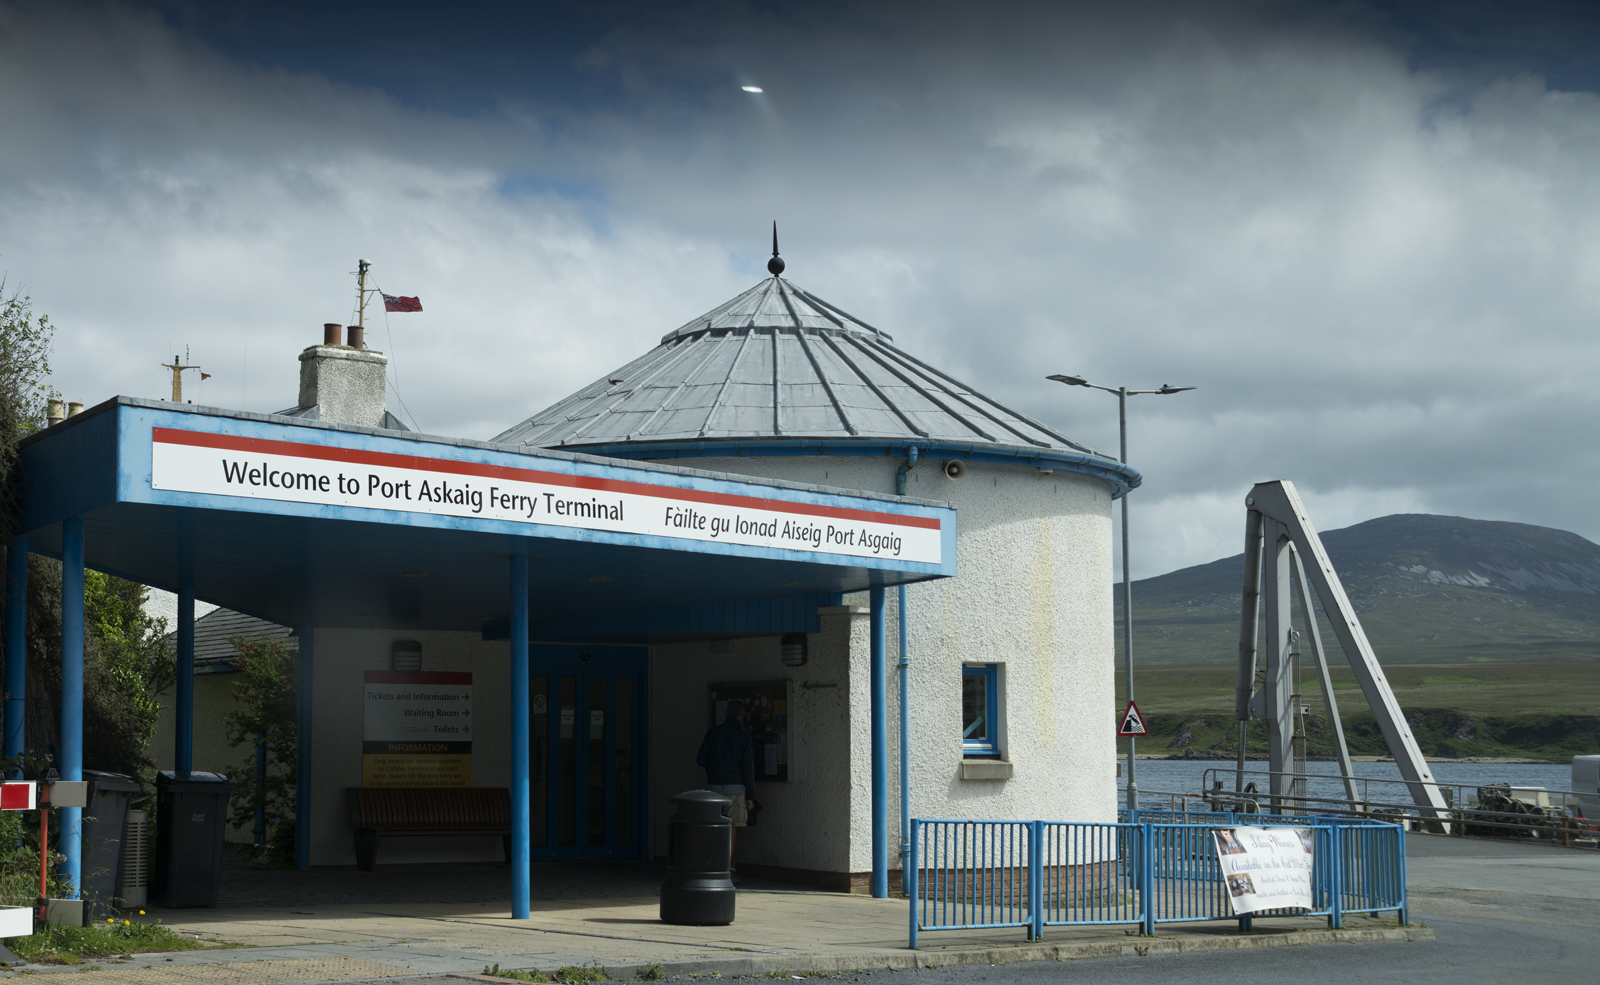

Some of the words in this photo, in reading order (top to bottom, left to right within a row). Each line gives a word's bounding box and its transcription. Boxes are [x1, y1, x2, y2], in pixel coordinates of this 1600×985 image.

[222, 459, 331, 492] Welcome
[338, 472, 360, 495] to
[367, 474, 412, 500] Port
[419, 479, 483, 513] Askaig
[490, 487, 537, 518] Ferry
[543, 492, 624, 521] Terminal
[665, 507, 706, 530] Fàilte
[711, 518, 730, 537] gu
[735, 515, 778, 538] Ionad
[781, 521, 822, 548] Aiseig
[826, 525, 855, 547] Port
[858, 528, 902, 556] Asgaig
[367, 692, 394, 700] Tickets
[396, 692, 411, 700] and
[413, 693, 459, 701] Information
[403, 709, 435, 719] Waiting
[436, 709, 459, 717] Room
[433, 725, 459, 733] Toilets
[388, 744, 448, 752] INFORMATION
[1249, 834, 1275, 854] Islay
[1231, 858, 1262, 872] Available
